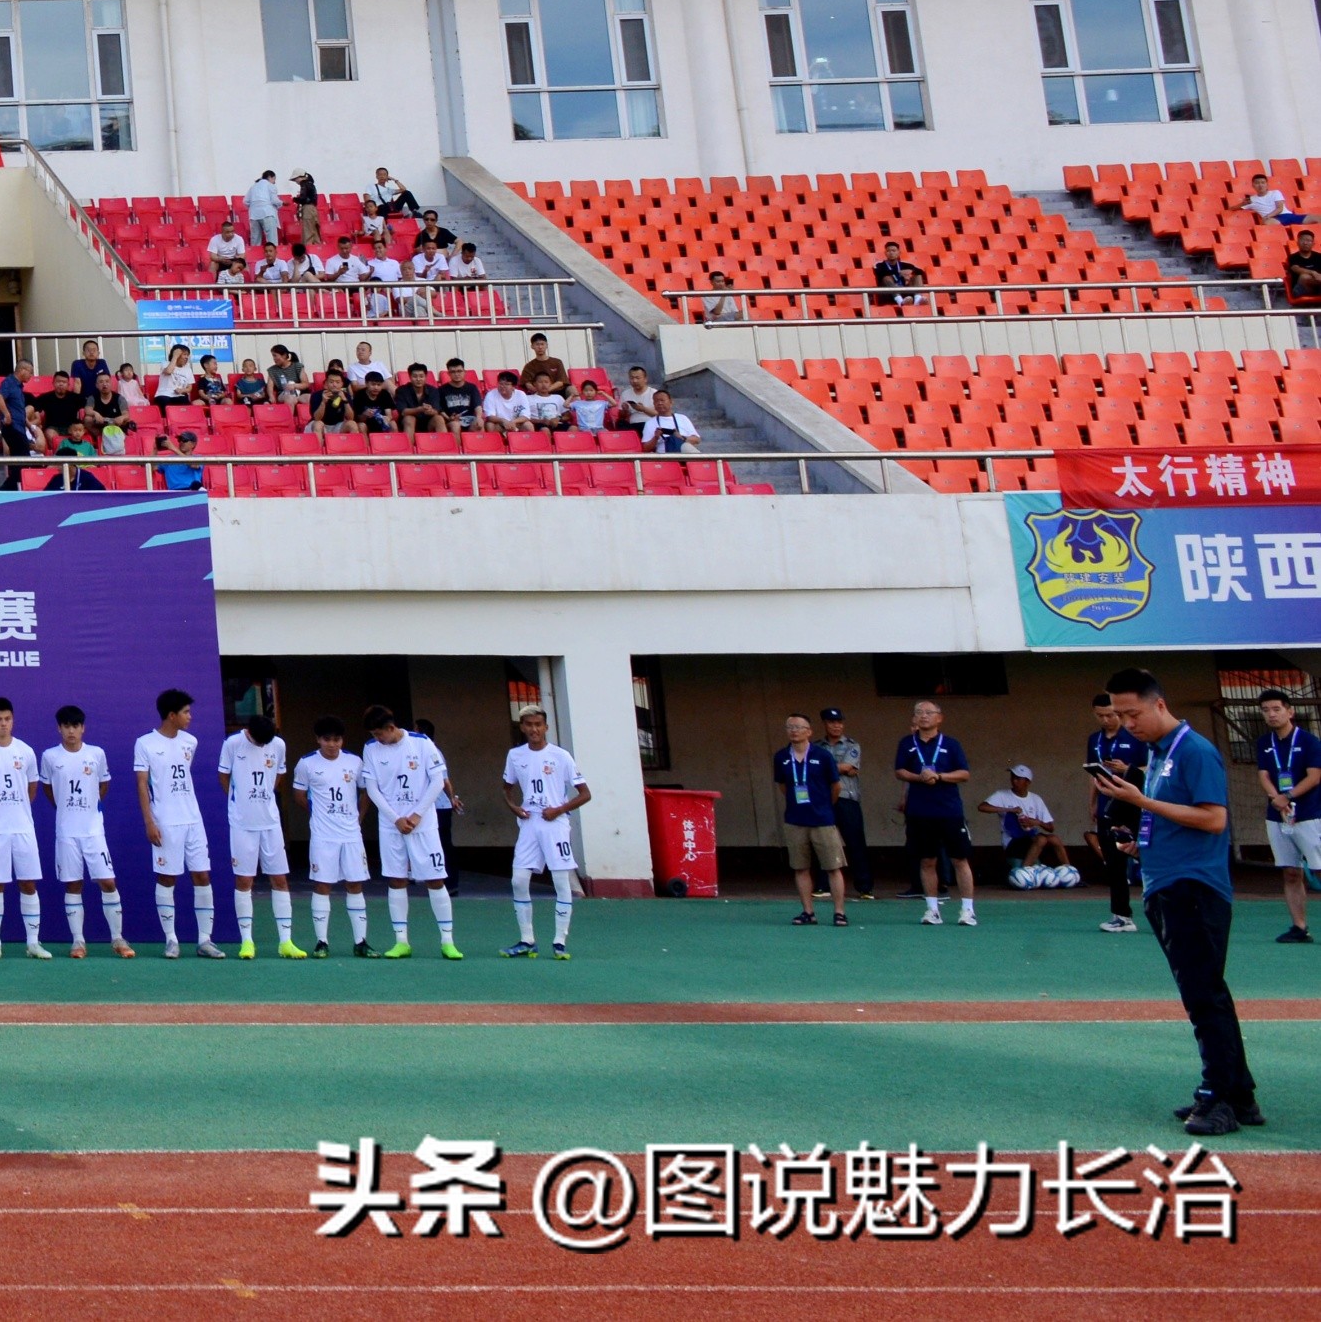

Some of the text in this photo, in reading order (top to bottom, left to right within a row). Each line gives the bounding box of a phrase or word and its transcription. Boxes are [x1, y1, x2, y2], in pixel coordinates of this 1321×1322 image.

[1111, 453, 1297, 497] 太行精神
[1174, 533, 1321, 602] 陕西
[171, 764, 186, 779] 25
[251, 771, 264, 786] 17
[4, 773, 13, 788] 5
[69, 779, 82, 794] 14
[531, 779, 543, 794] 10
[329, 787, 343, 802] 16
[556, 841, 571, 857] 10
[429, 852, 444, 867] 12
